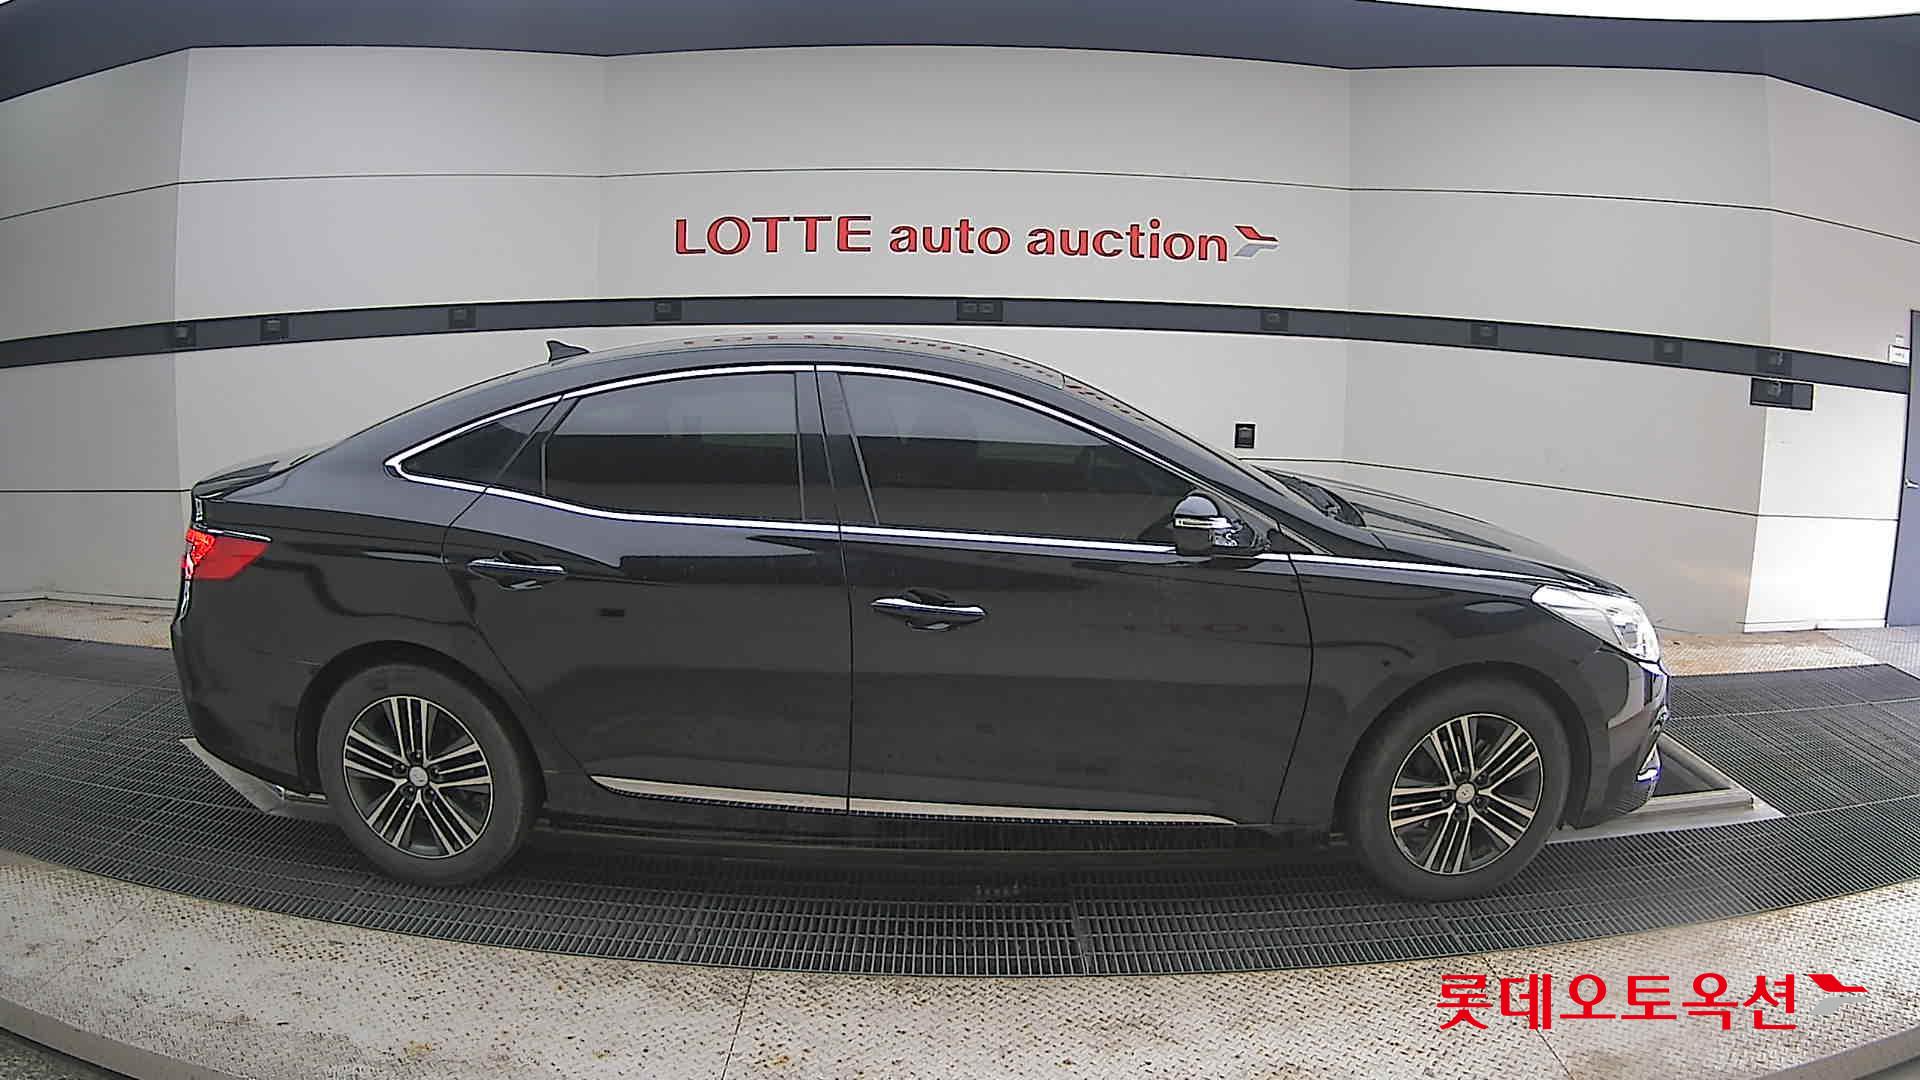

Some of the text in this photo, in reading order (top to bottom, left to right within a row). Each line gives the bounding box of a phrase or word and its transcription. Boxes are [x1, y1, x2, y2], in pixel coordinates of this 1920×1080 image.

[675, 215, 1228, 262] LOTTE auto auction
